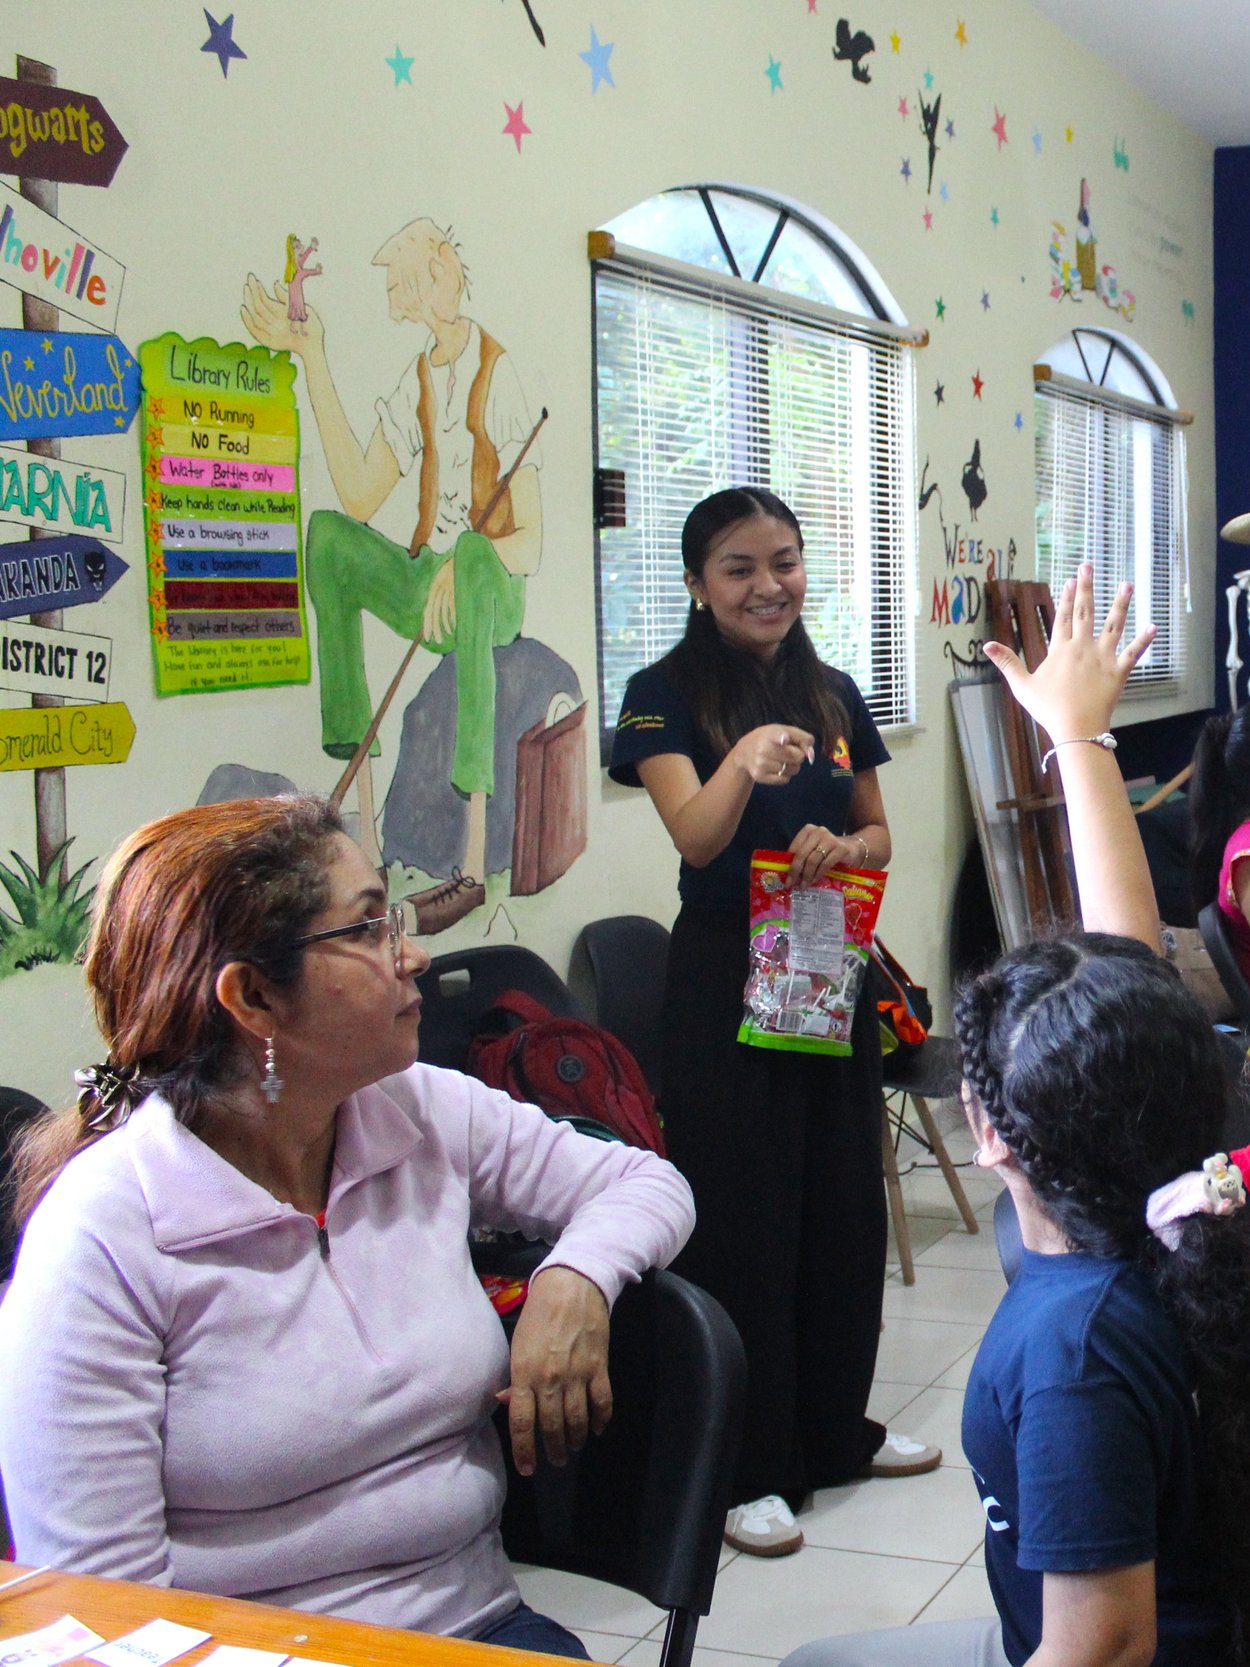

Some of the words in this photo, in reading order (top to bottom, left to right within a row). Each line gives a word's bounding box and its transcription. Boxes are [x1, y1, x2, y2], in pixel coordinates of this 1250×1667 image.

[171, 345, 231, 390] Library
[237, 360, 270, 393] Rules
[210, 401, 254, 429] Running
[218, 434, 250, 455] Food
[169, 460, 205, 478] Water
[213, 463, 249, 483] Bottles
[252, 469, 274, 486] only
[0, 457, 112, 532] ARNIA
[161, 492, 182, 510] Keep
[187, 495, 213, 511] hands
[244, 500, 266, 514] while
[168, 524, 185, 539] Use
[188, 529, 195, 539] a
[200, 524, 244, 546] browsing
[247, 528, 270, 540] stick
[167, 617, 181, 635] Be
[213, 617, 228, 633] and
[264, 619, 295, 633] others
[0, 636, 78, 679] ISTRICT
[86, 651, 106, 684] 12
[69, 711, 114, 757] City
[114, 1642, 161, 1664] Teacher
